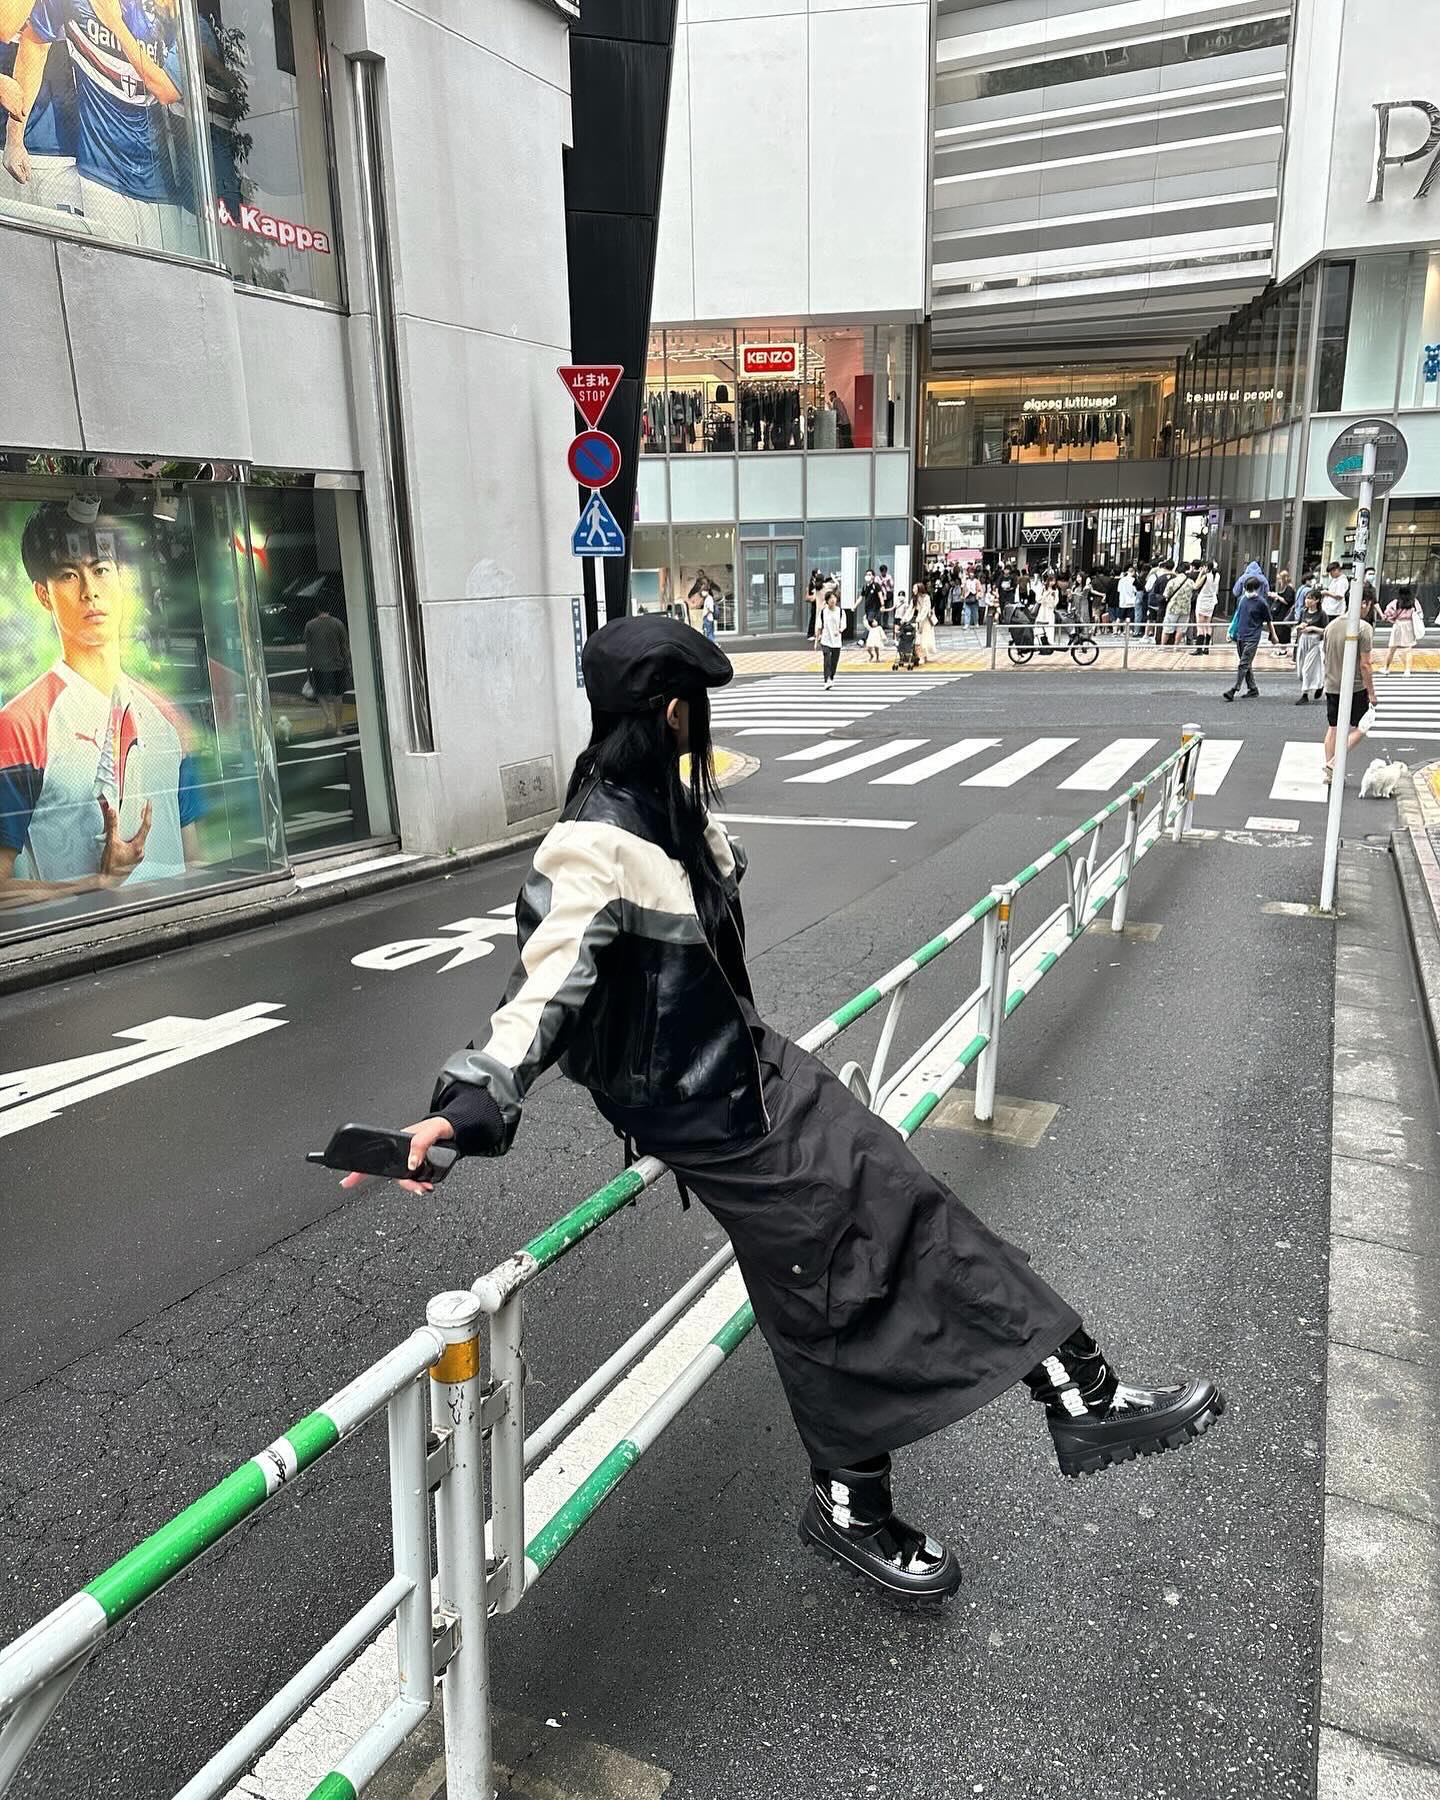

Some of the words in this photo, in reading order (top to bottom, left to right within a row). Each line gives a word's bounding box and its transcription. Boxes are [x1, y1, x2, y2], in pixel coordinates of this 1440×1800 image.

[240, 204, 331, 254] Kappa
[747, 350, 793, 364] KENZO
[571, 372, 611, 388] 止まれ
[579, 390, 606, 402] STOP
[1185, 389, 1240, 403] beautiful
[1243, 388, 1284, 402] people
